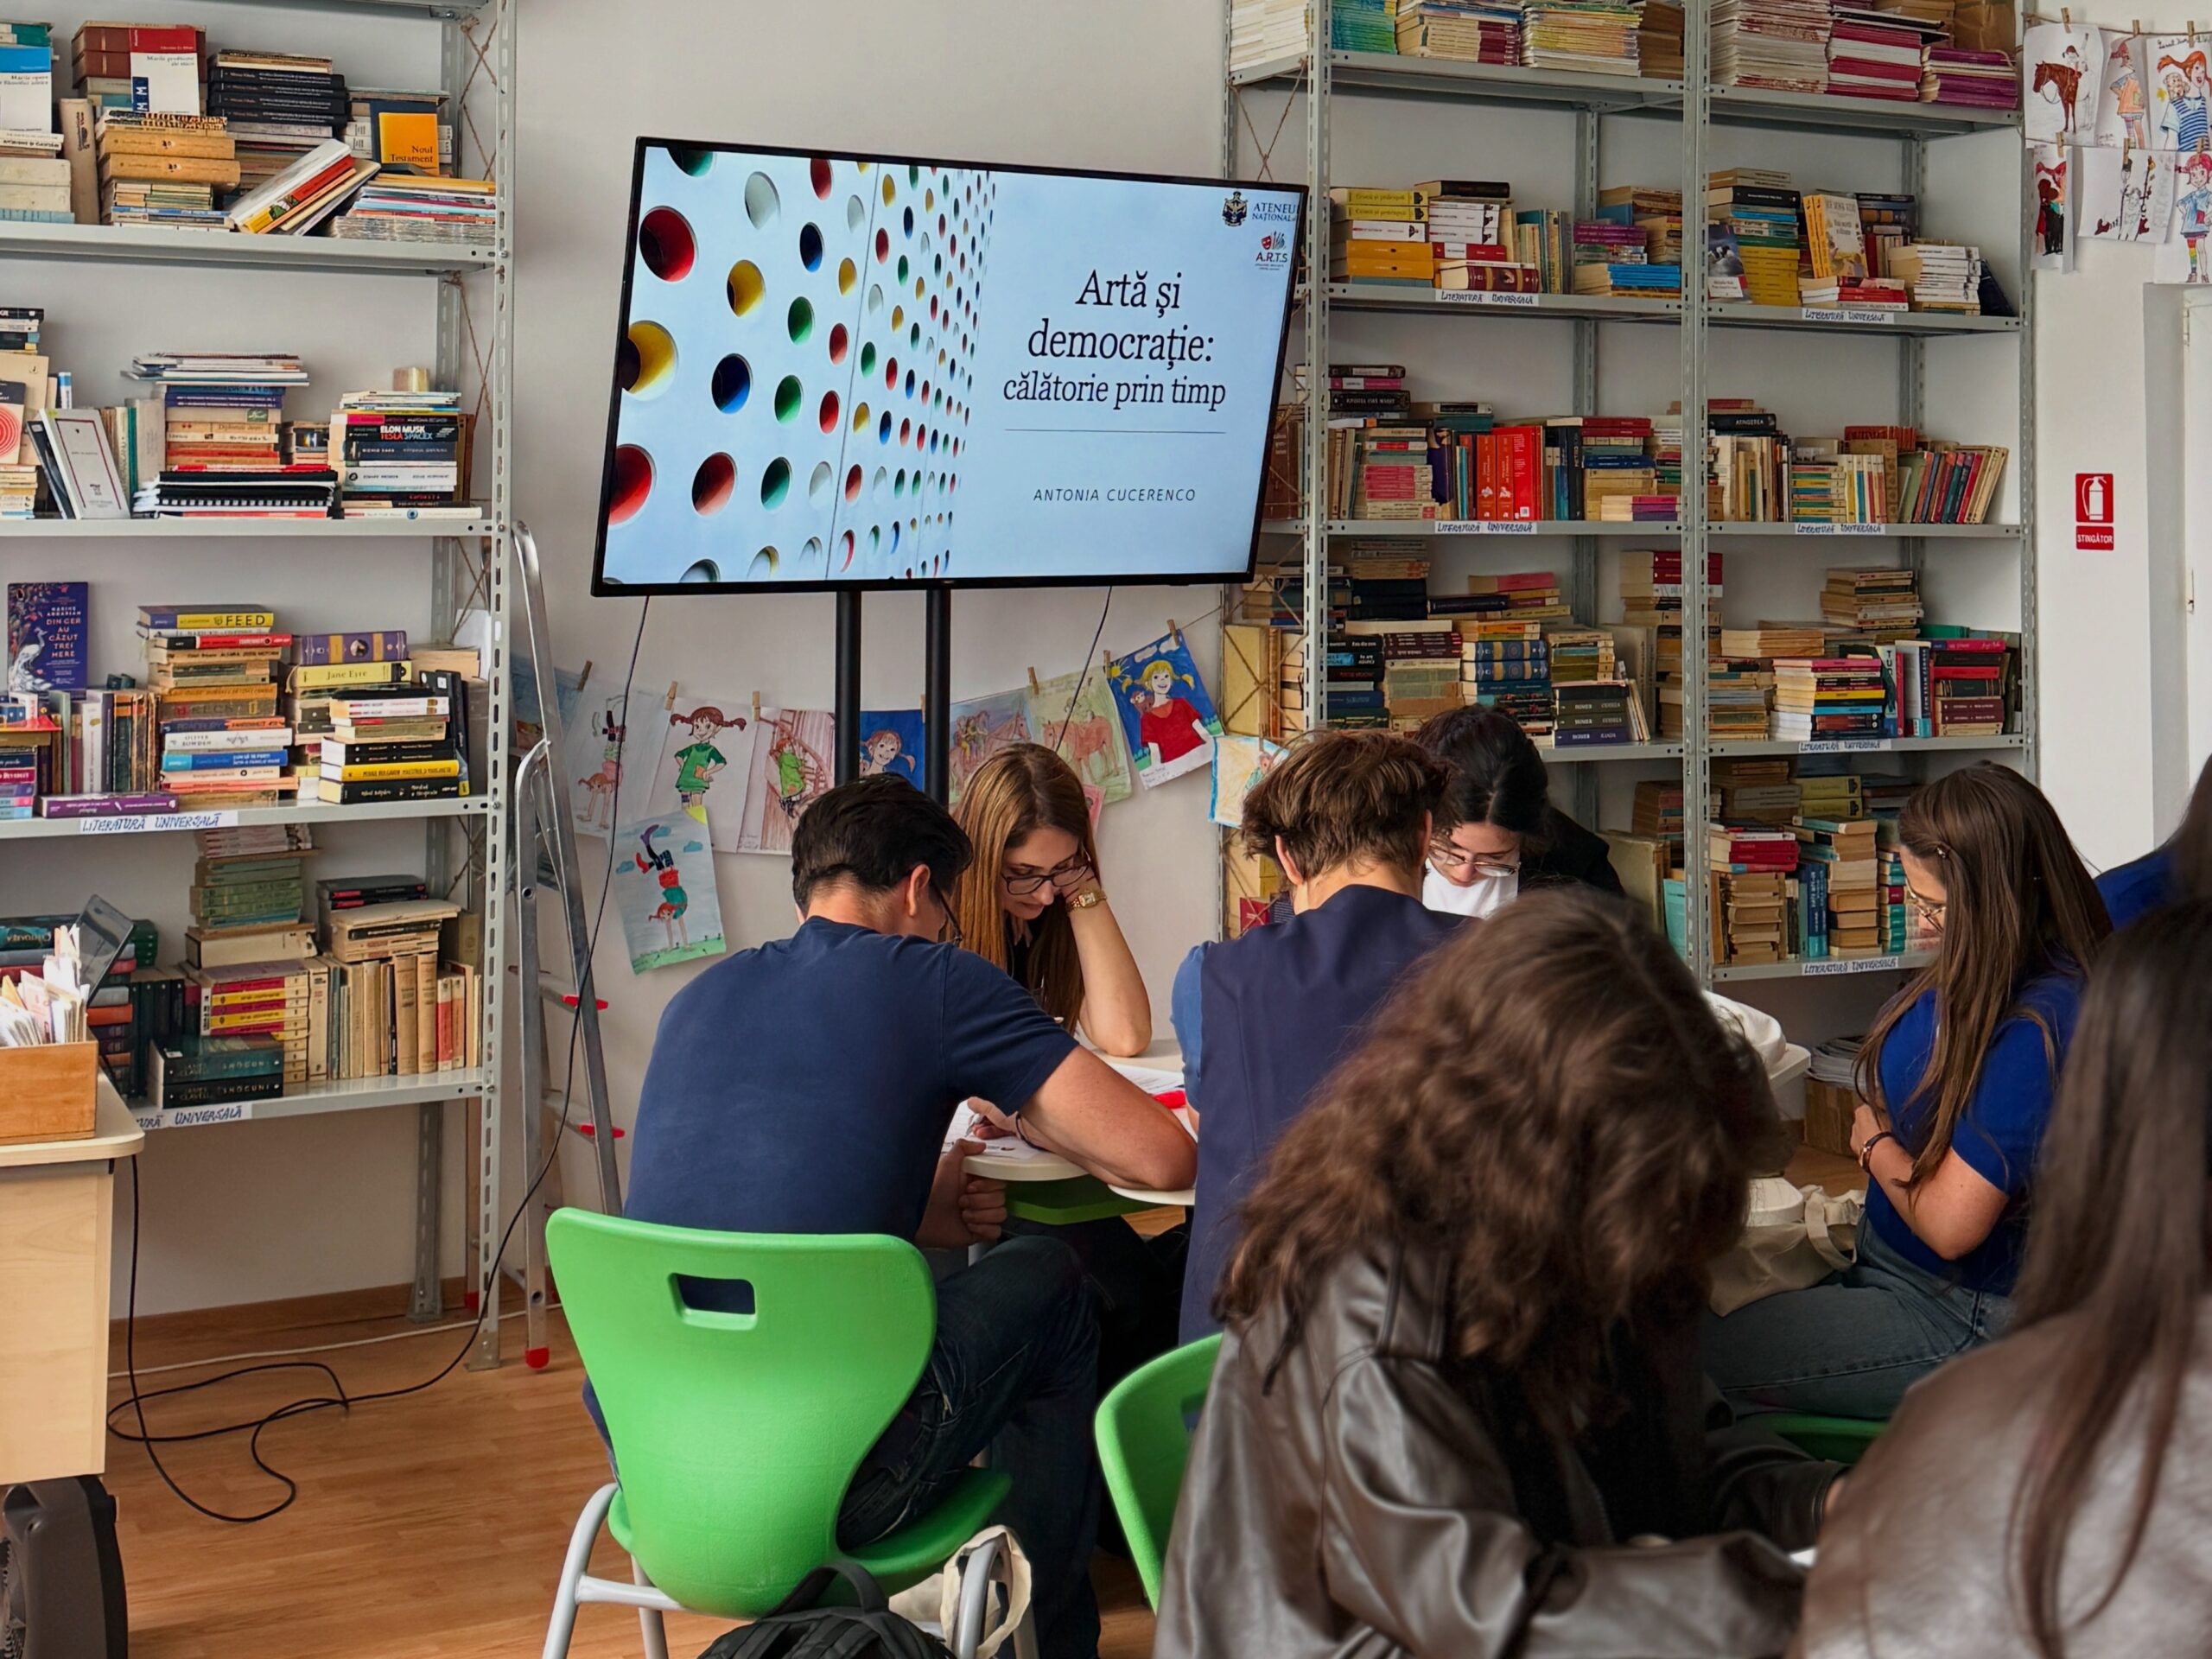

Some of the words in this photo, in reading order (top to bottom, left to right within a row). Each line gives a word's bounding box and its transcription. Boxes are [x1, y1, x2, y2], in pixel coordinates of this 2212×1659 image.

[1075, 270, 1147, 308] Artă
[1156, 271, 1182, 318] și
[1028, 318, 1214, 371] democrație:
[1003, 371, 1109, 403] călătorie
[1113, 374, 1165, 410] prin
[1172, 375, 1225, 412] timp
[1033, 488, 1099, 501] ANTONIA
[1107, 488, 1196, 502] CUCERENCO
[226, 614, 265, 626] FEED
[327, 671, 346, 681] Jane
[348, 670, 367, 679] Eyre
[82, 815, 148, 832] LITERATURĂ
[156, 812, 222, 829] UNIVERSALĂ
[175, 1105, 243, 1125] UNIVERSALĂ
